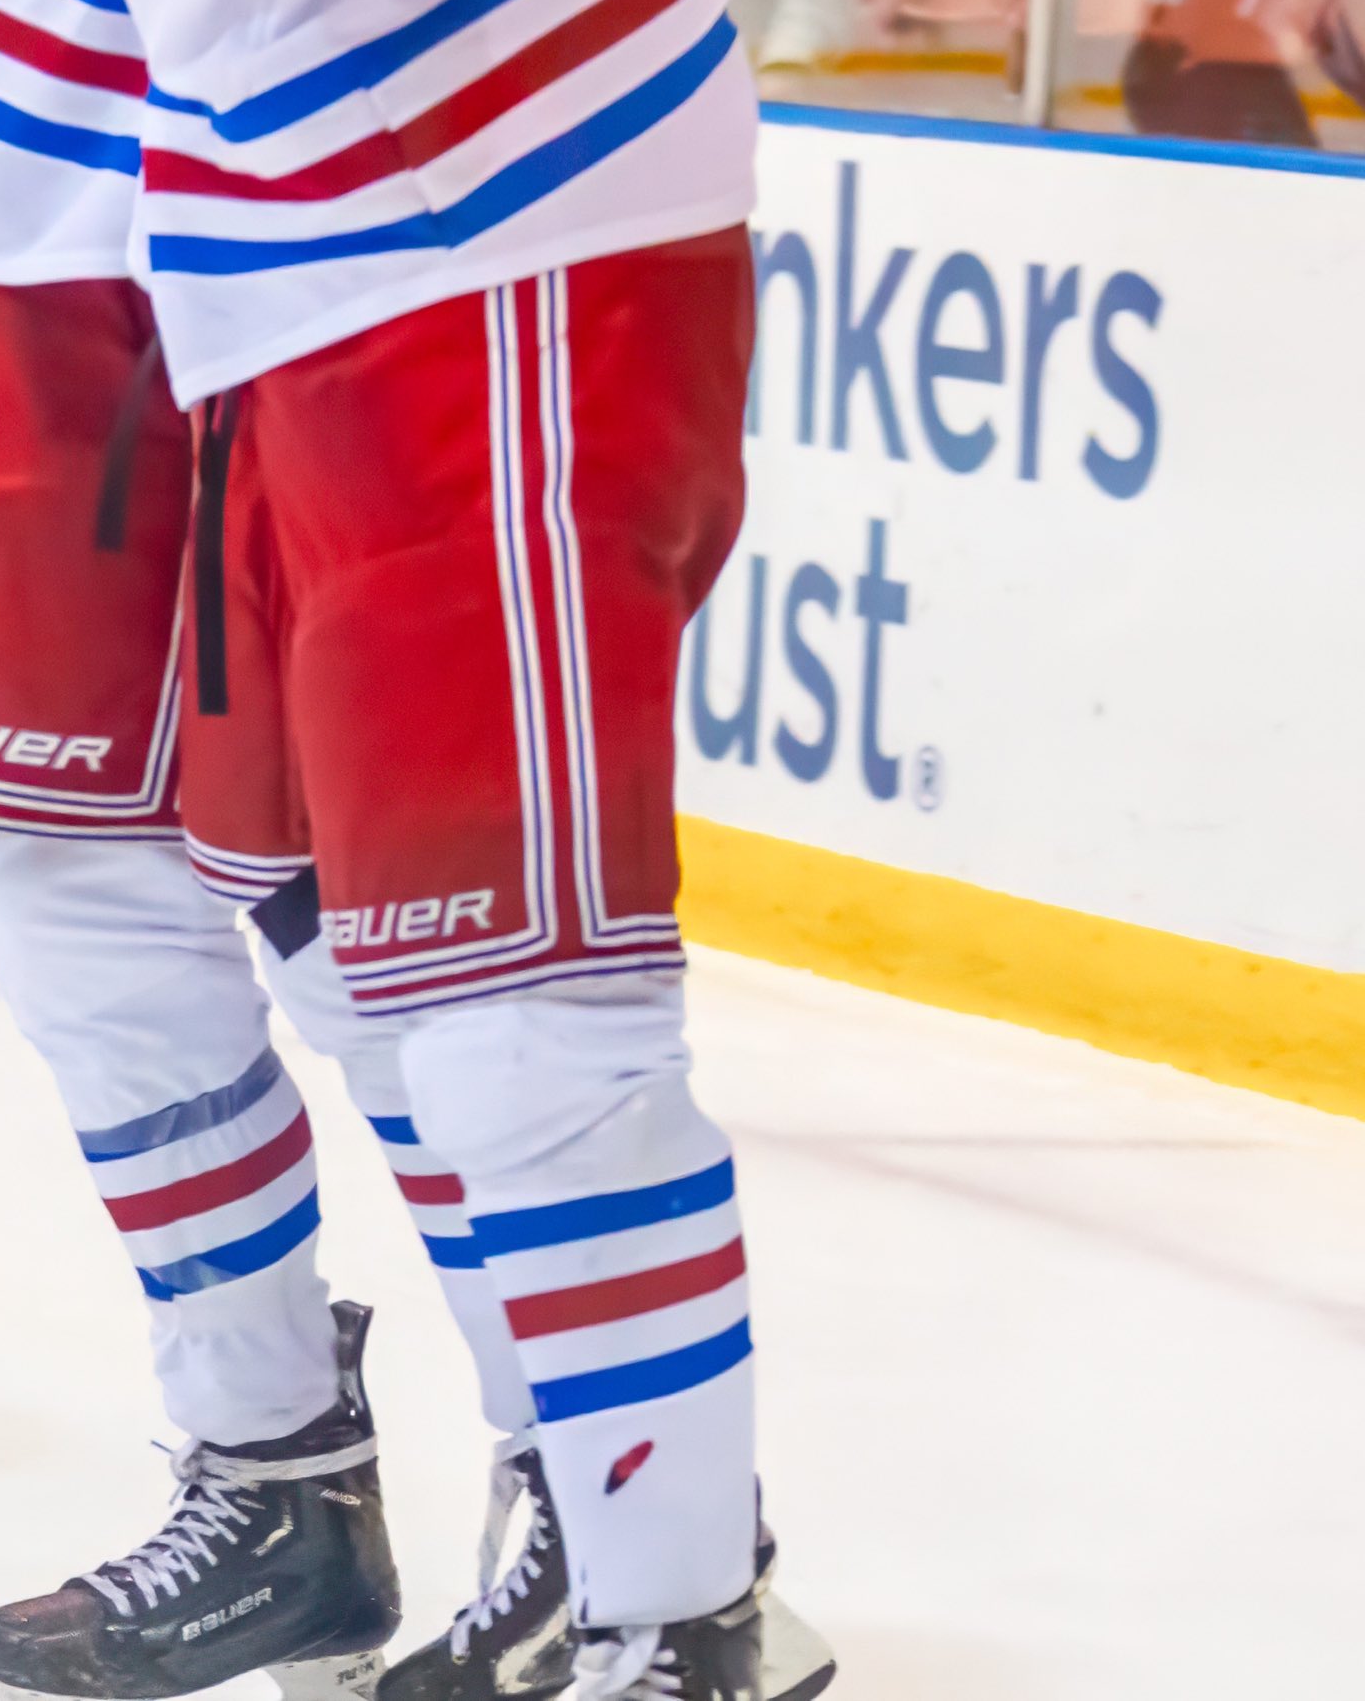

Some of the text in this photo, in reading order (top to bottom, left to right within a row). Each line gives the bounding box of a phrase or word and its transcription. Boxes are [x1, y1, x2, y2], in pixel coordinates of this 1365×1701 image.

[745, 159, 1164, 500] nkers
[687, 518, 909, 802] ust
[181, 1587, 273, 1642] BAUER
